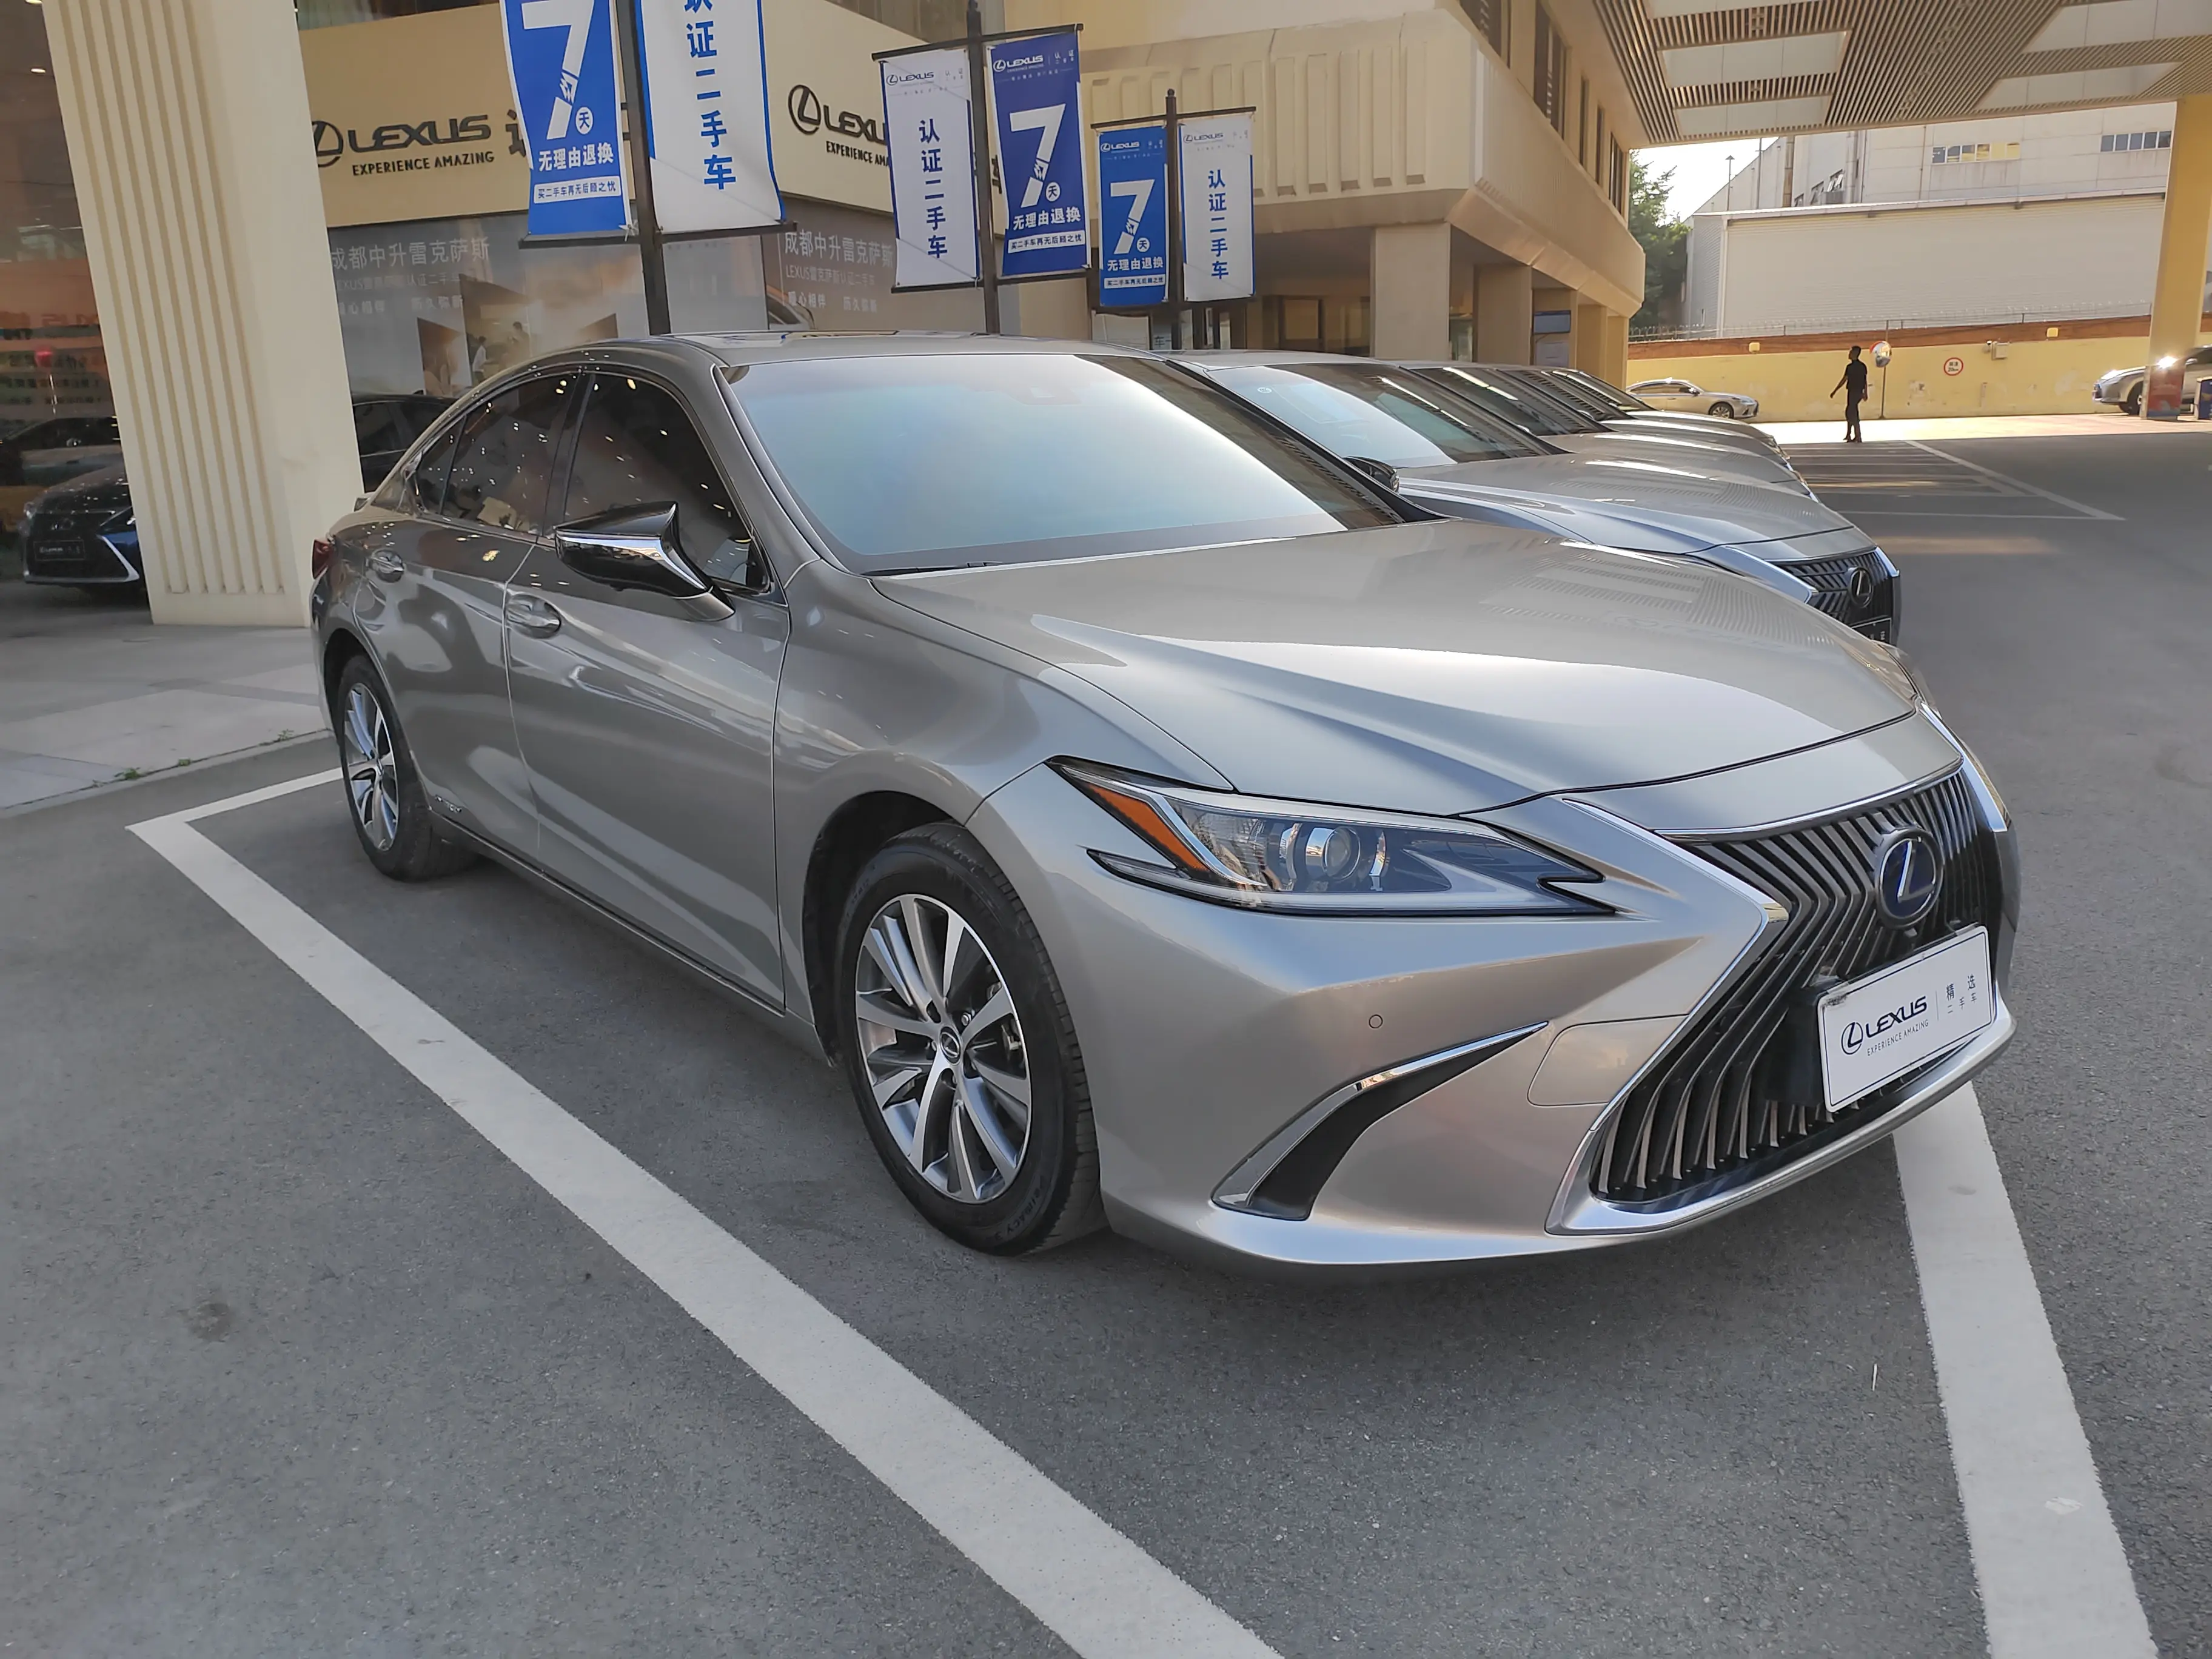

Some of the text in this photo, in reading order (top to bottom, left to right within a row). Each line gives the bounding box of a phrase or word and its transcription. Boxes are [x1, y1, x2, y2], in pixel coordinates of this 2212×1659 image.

[1007, 55, 1043, 67] LEXUS
[899, 72, 934, 82] LEXUS
[347, 115, 491, 153] LEXUS
[823, 105, 887, 146] LEXU
[538, 142, 614, 172] 无理由退换
[826, 141, 873, 164] EXPERIENCE
[1111, 141, 1139, 150] LEXUS
[352, 151, 495, 176] EXPERIENCE AMAZING
[538, 179, 616, 199] 买二手车再无后顾之忧
[919, 118, 947, 259] 认证二手车
[1013, 206, 1081, 230] 无理由退换
[1208, 169, 1229, 279] 认证二手车
[785, 229, 894, 268] 成都中升雷克萨斯
[1011, 234, 1082, 250] 买二手车再无后顾之忧
[1107, 256, 1164, 272] 无理由退换
[1865, 996, 1927, 1038] LEXUS
[1867, 1019, 1929, 1056] EXPERIENCE AMAZING
